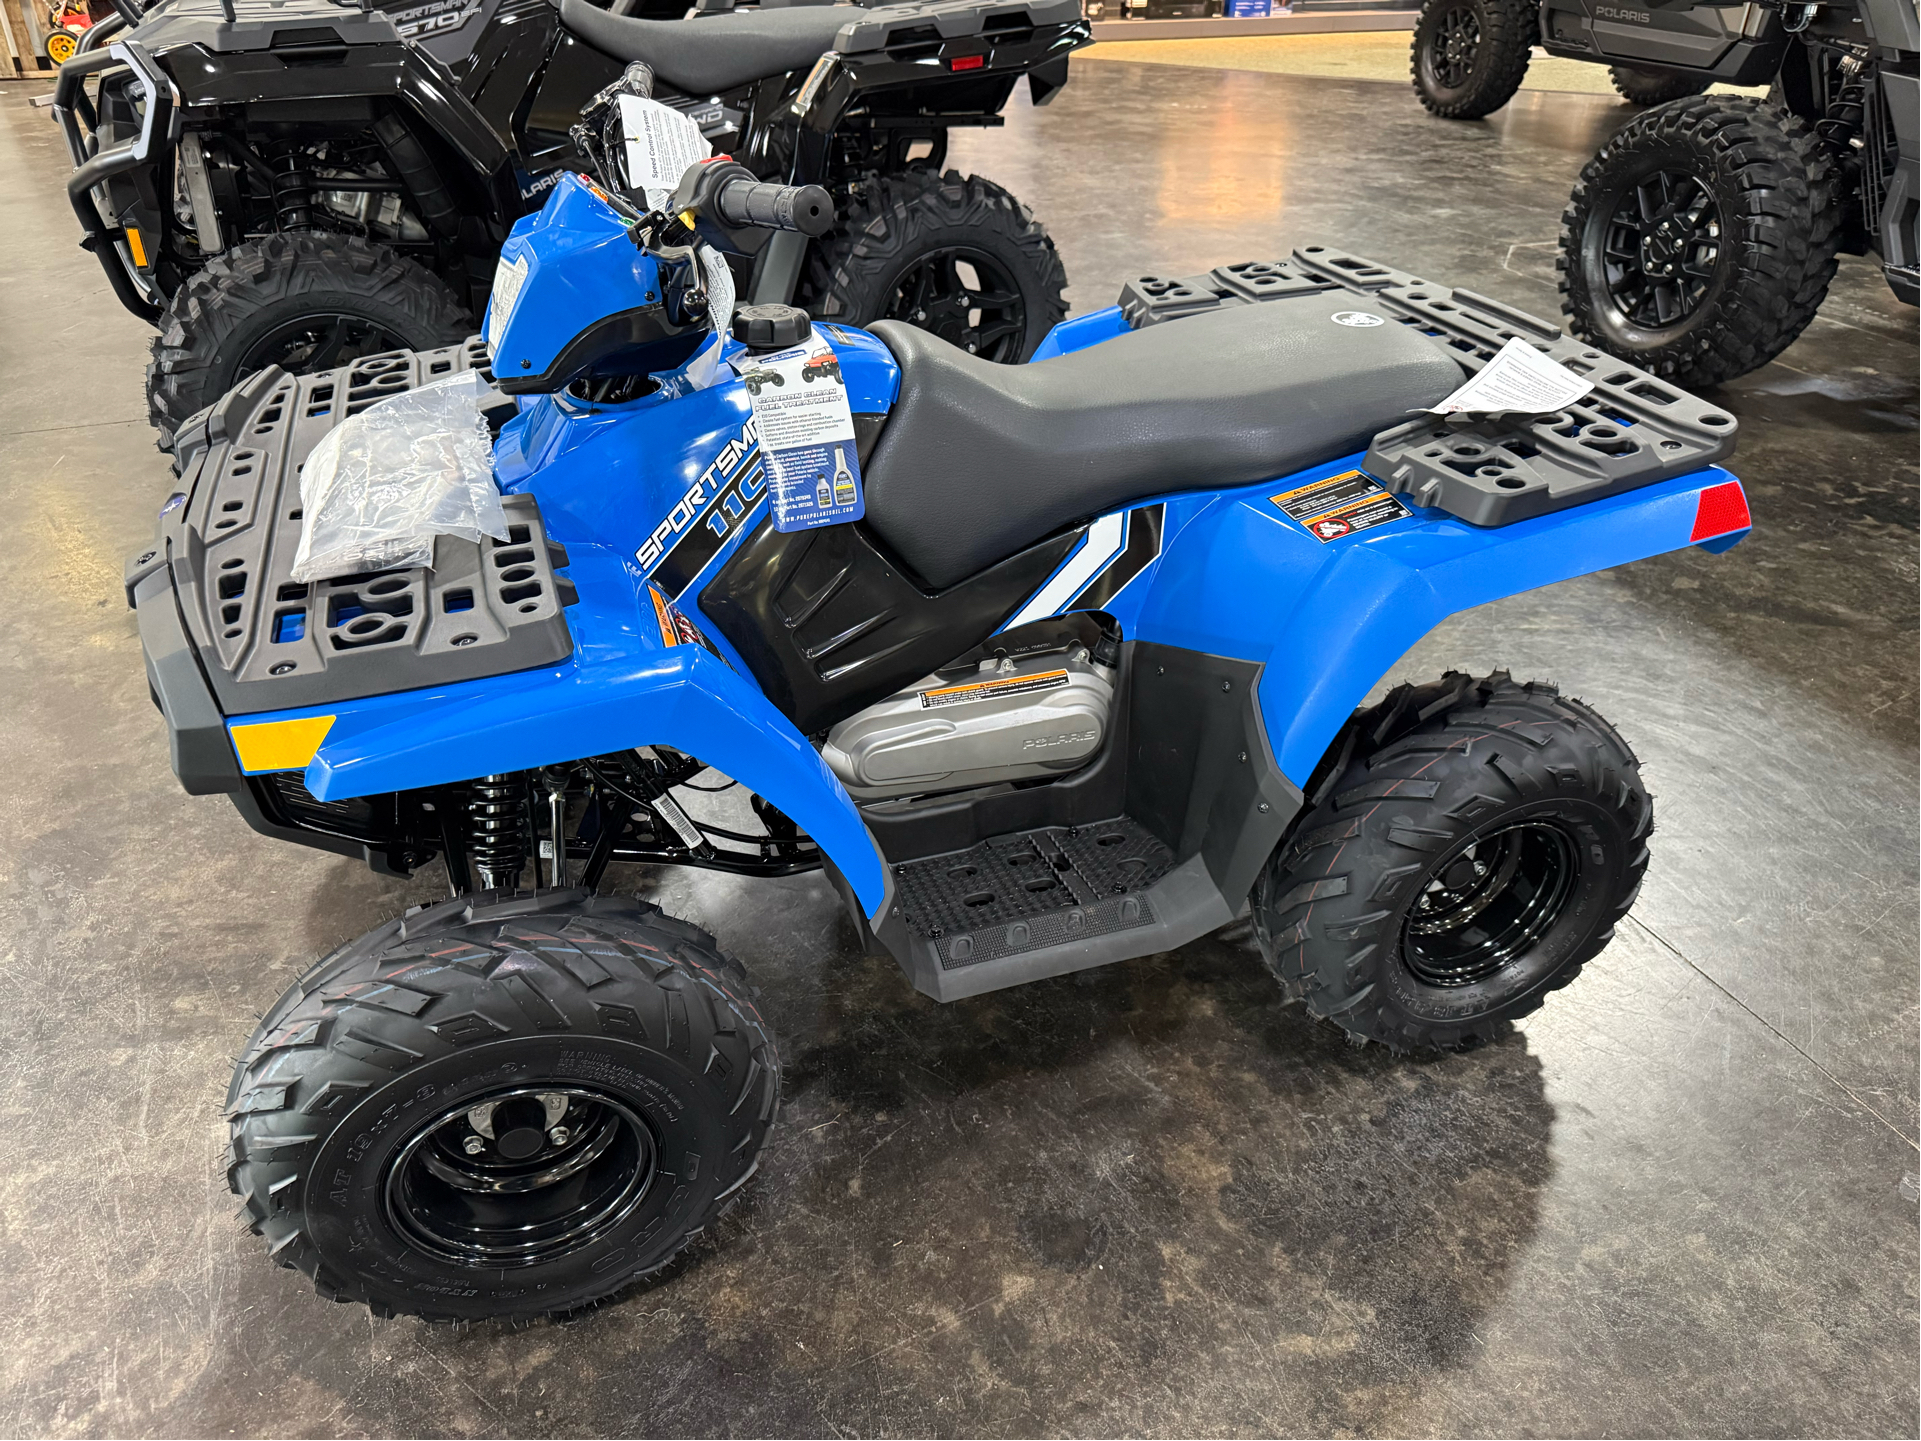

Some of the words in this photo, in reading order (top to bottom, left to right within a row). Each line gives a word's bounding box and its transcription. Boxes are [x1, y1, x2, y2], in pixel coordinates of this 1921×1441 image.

[396, 11, 460, 36] 570
[1596, 6, 1650, 23] POLARIS
[642, 109, 652, 133] System
[647, 133, 656, 156] Control
[651, 158, 659, 179] Speed
[521, 168, 565, 201] LARIS
[755, 403, 782, 412] FUEL
[783, 395, 843, 409] TREATMENT
[758, 392, 802, 404] CARBON
[804, 388, 837, 398] CLEAN
[1300, 476, 1340, 492] WARNING
[706, 463, 768, 538] 110
[1330, 499, 1369, 516] WARNING
[1023, 730, 1096, 750] POLARIS
[560, 1050, 616, 1064] WARNING:
